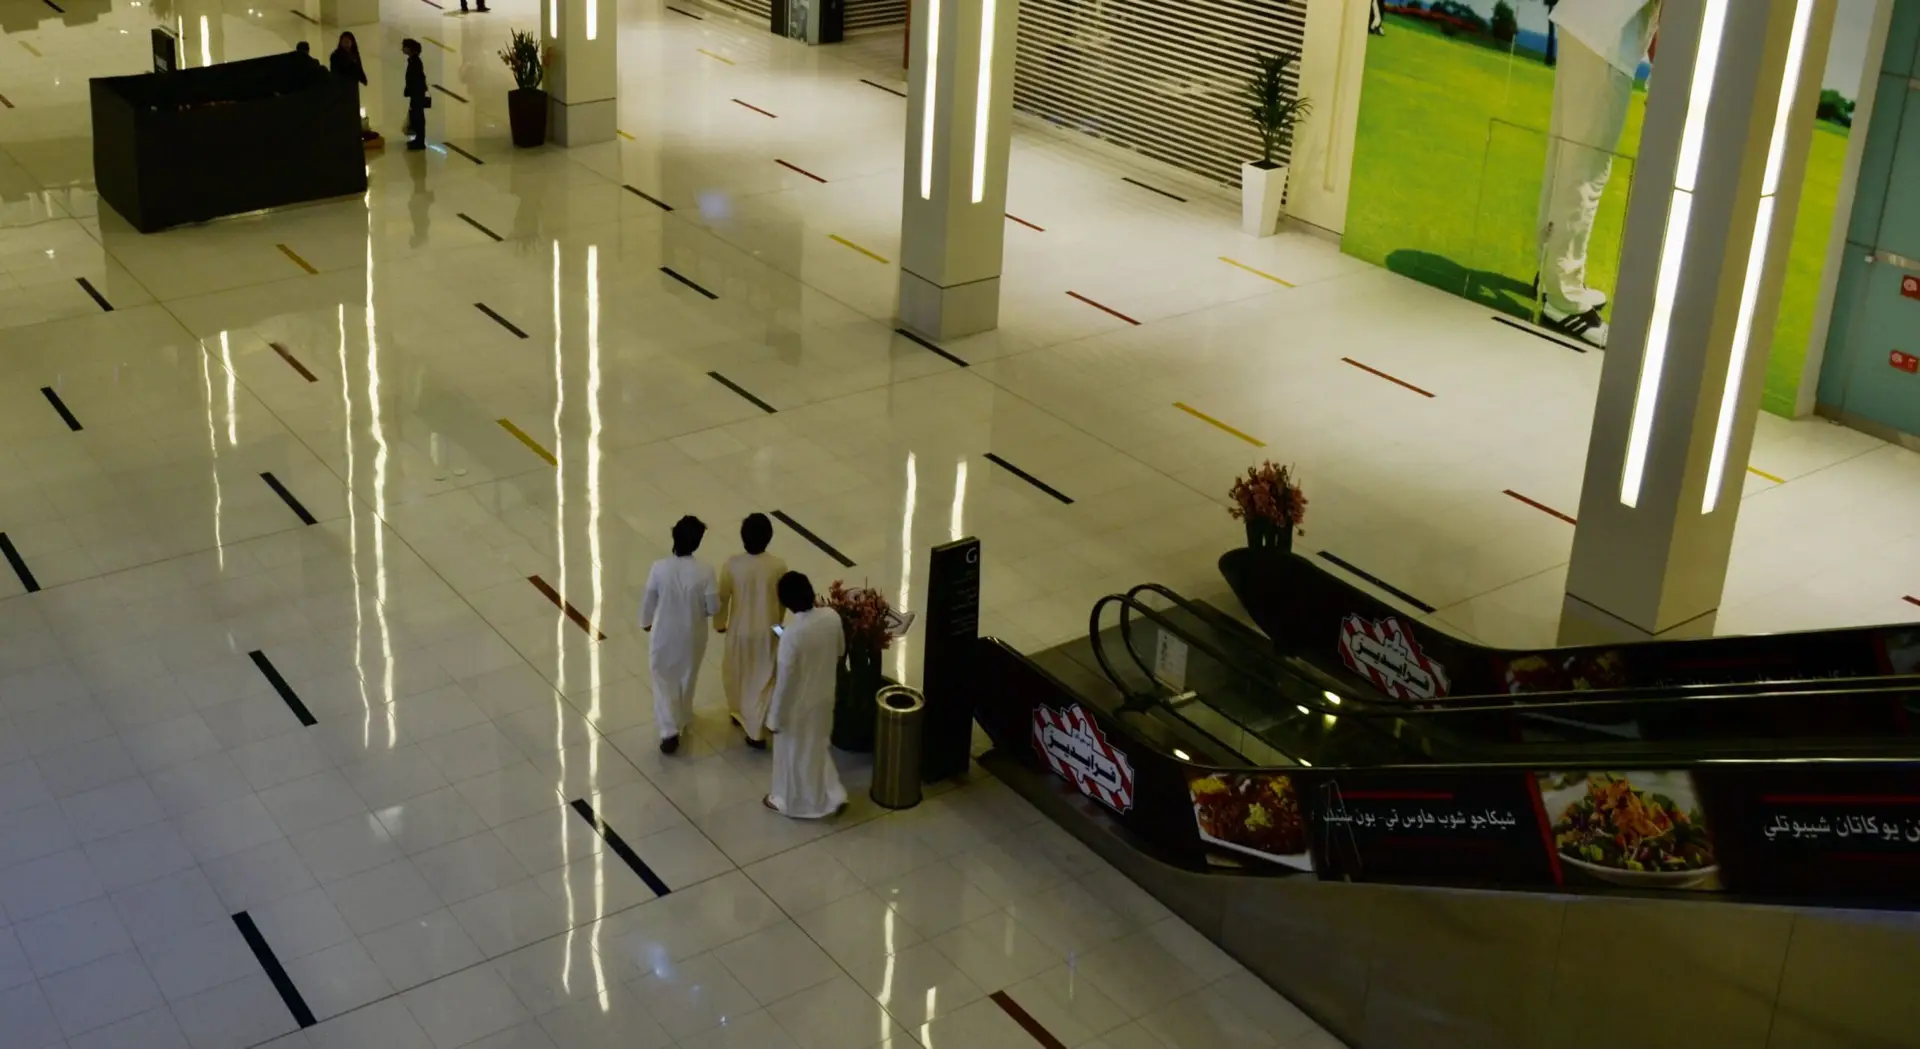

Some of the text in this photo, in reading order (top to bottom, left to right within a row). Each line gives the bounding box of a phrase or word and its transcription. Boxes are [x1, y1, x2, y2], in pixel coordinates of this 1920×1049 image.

[965, 547, 978, 564] G
[1402, 808, 1436, 829] هاوس
[1438, 809, 1467, 830] شوب
[1470, 808, 1517, 831] شيكاجو
[1763, 813, 1831, 842] شيبوتلي
